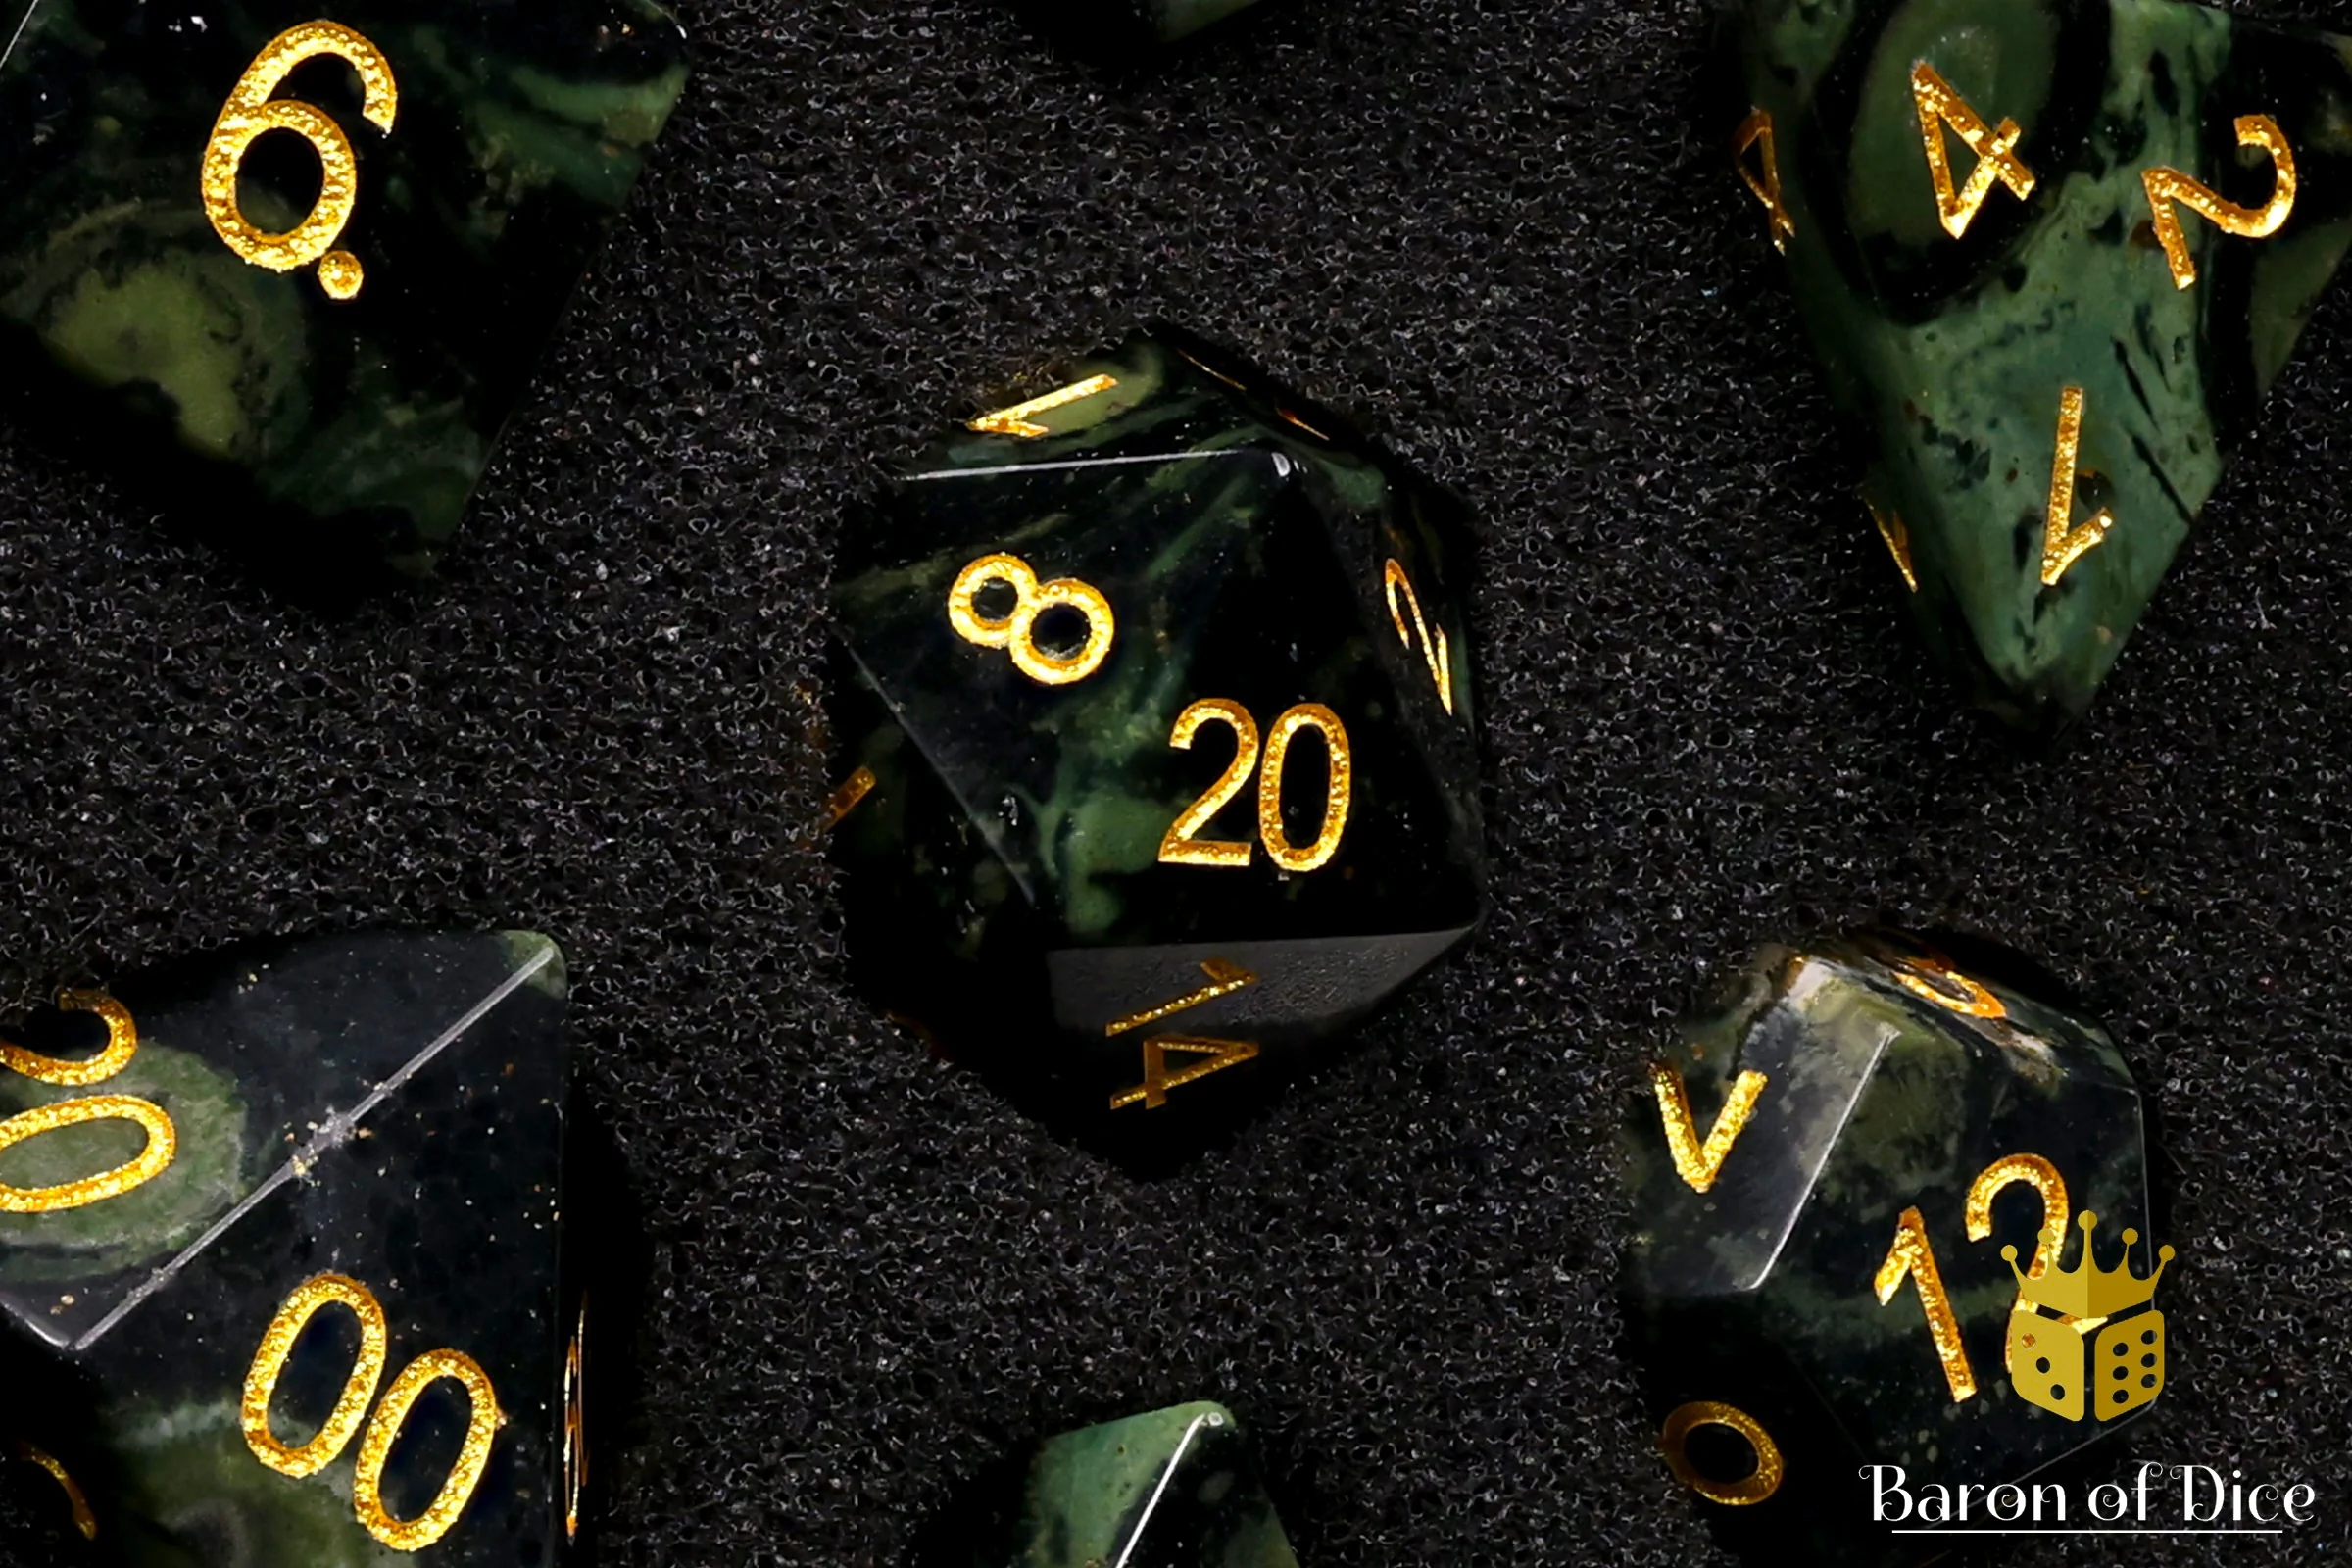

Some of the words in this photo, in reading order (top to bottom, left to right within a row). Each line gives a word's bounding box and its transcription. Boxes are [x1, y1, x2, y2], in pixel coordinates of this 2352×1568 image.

[1910, 62, 2036, 240] 4
[2141, 113, 2297, 290] 2
[2040, 387, 2114, 586] 1
[946, 551, 1117, 686] 8
[1156, 697, 1352, 873] 20
[1104, 956, 1261, 1111] 14
[241, 1272, 505, 1552] 00
